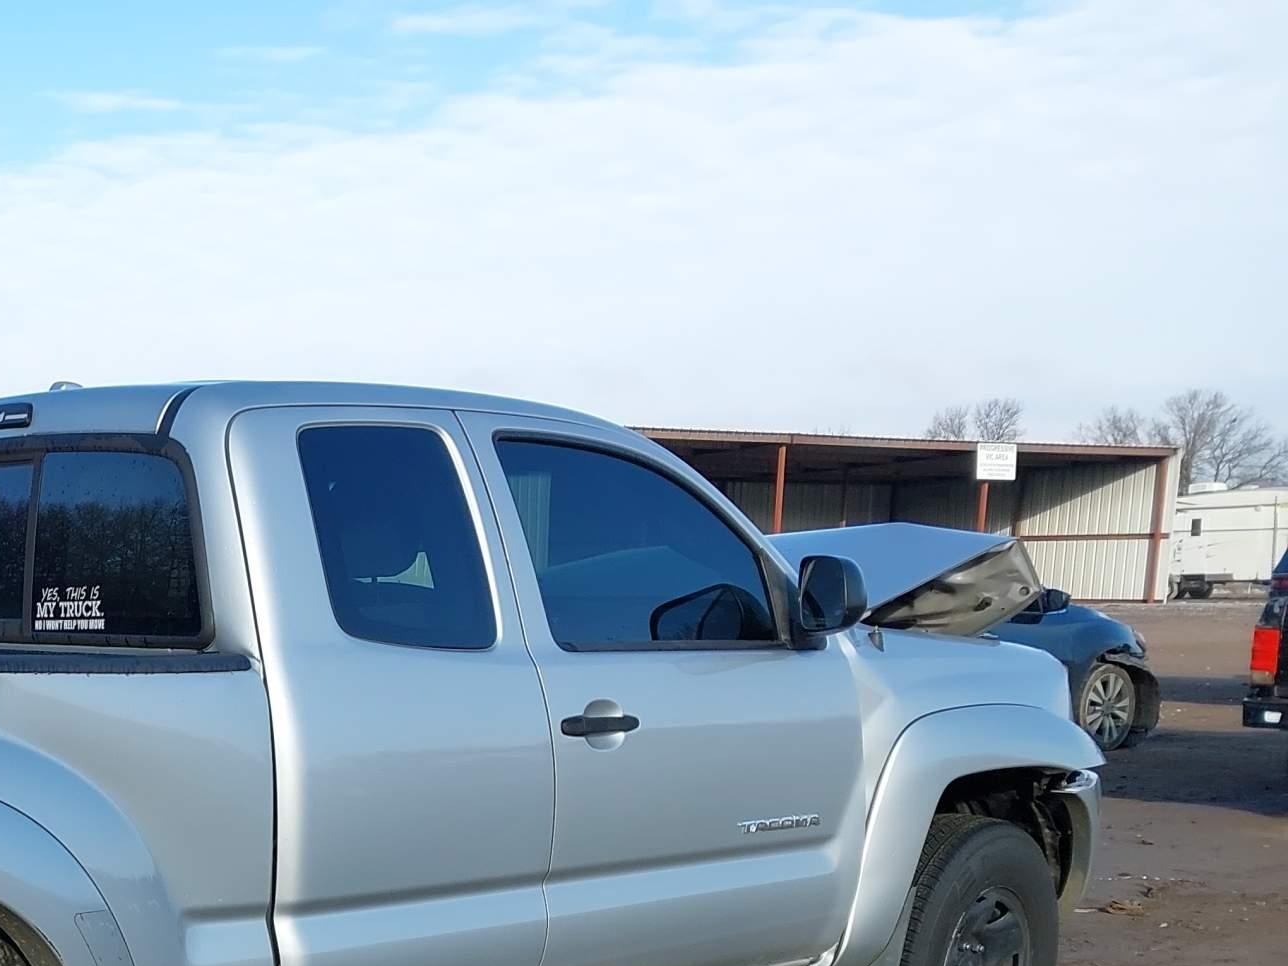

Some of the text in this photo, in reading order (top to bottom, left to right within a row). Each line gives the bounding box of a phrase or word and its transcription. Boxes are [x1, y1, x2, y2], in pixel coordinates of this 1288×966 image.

[41, 585, 100, 602] YES, THIS IS
[36, 600, 104, 618] MY TRUCK.
[63, 619, 77, 630] HELP
[76, 619, 89, 630] YOU
[737, 813, 820, 834] TACOMA
